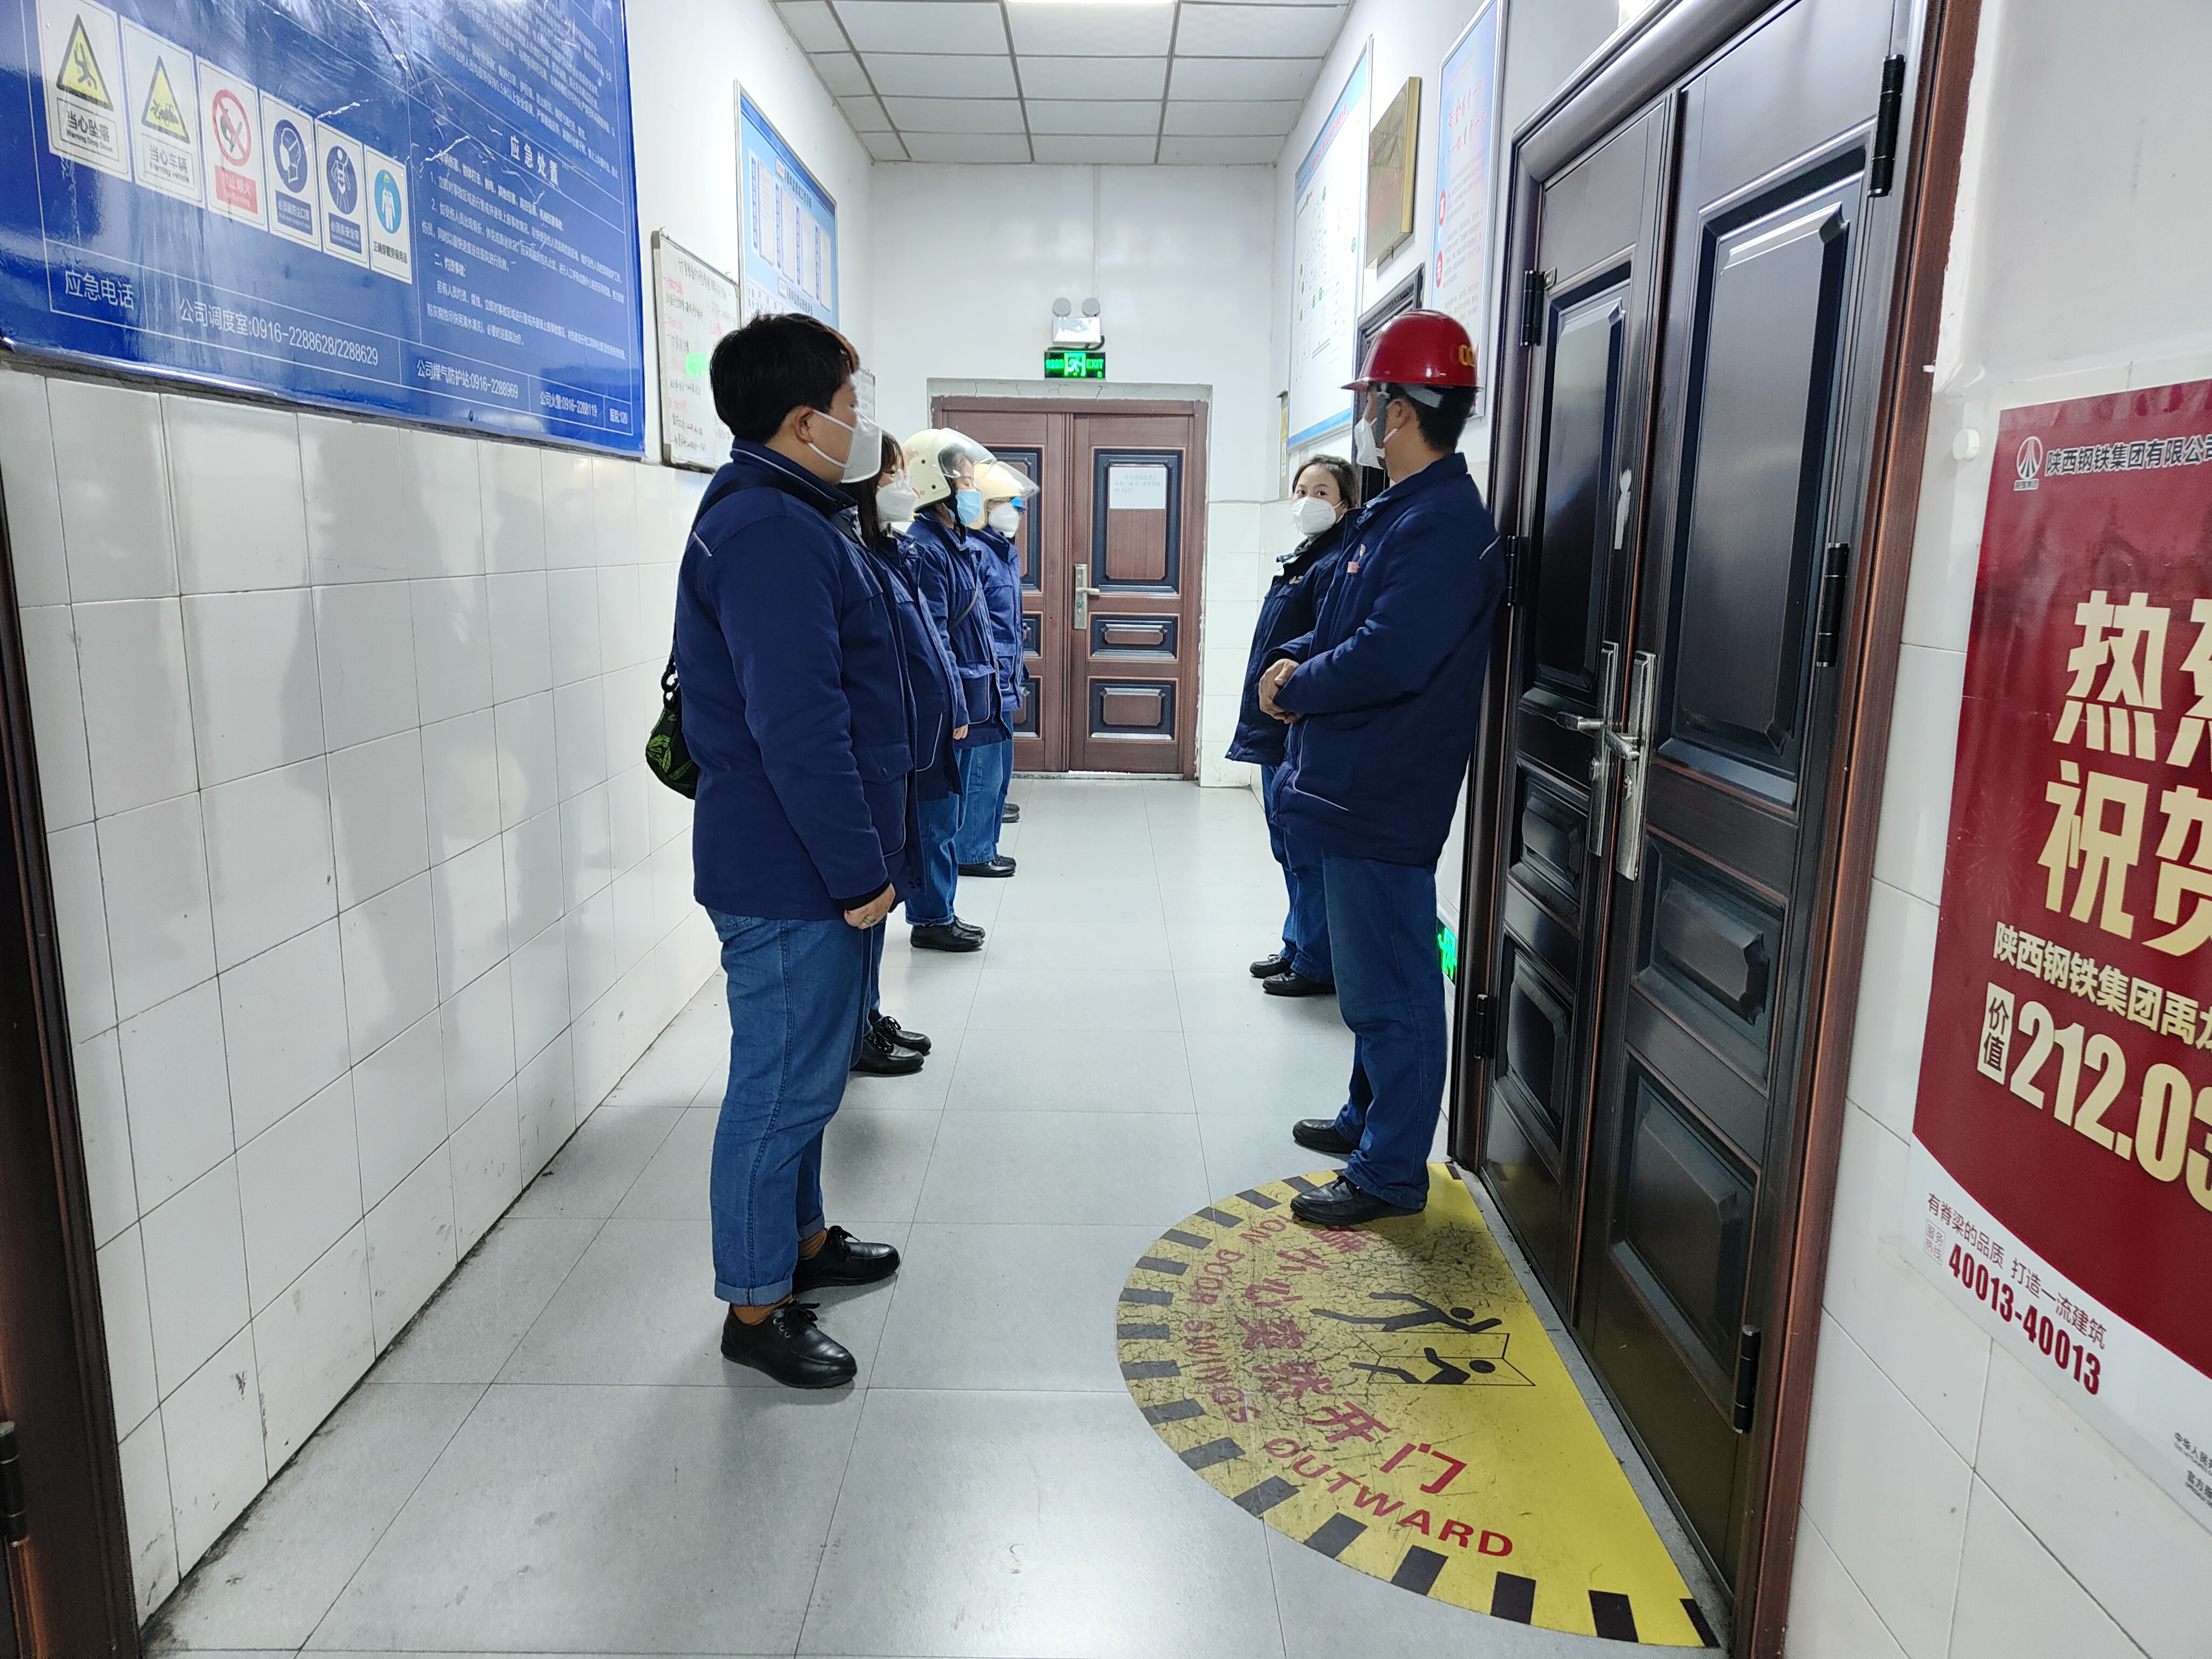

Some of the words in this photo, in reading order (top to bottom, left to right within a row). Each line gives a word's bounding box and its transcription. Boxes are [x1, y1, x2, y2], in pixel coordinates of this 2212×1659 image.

[66, 110, 110, 143] 当心坠落
[150, 144, 187, 173] 当心车辆
[510, 135, 558, 186] 应急处置
[65, 269, 134, 311] 应急电话
[179, 298, 379, 367] 公司调度室:0916-2288628/2288629
[1086, 358, 1104, 369] EXIT
[1984, 996, 2009, 1072] 价值
[1188, 1249, 1246, 1305] DOOR
[1927, 1192, 2005, 1270] 有脊梁的品质
[2011, 1257, 2107, 1350] 打造一流建筑
[1948, 1243, 2102, 1395] 40013-40013
[1184, 1319, 1262, 1424] SWINGS
[1264, 1437, 1513, 1558] OUTWARD
